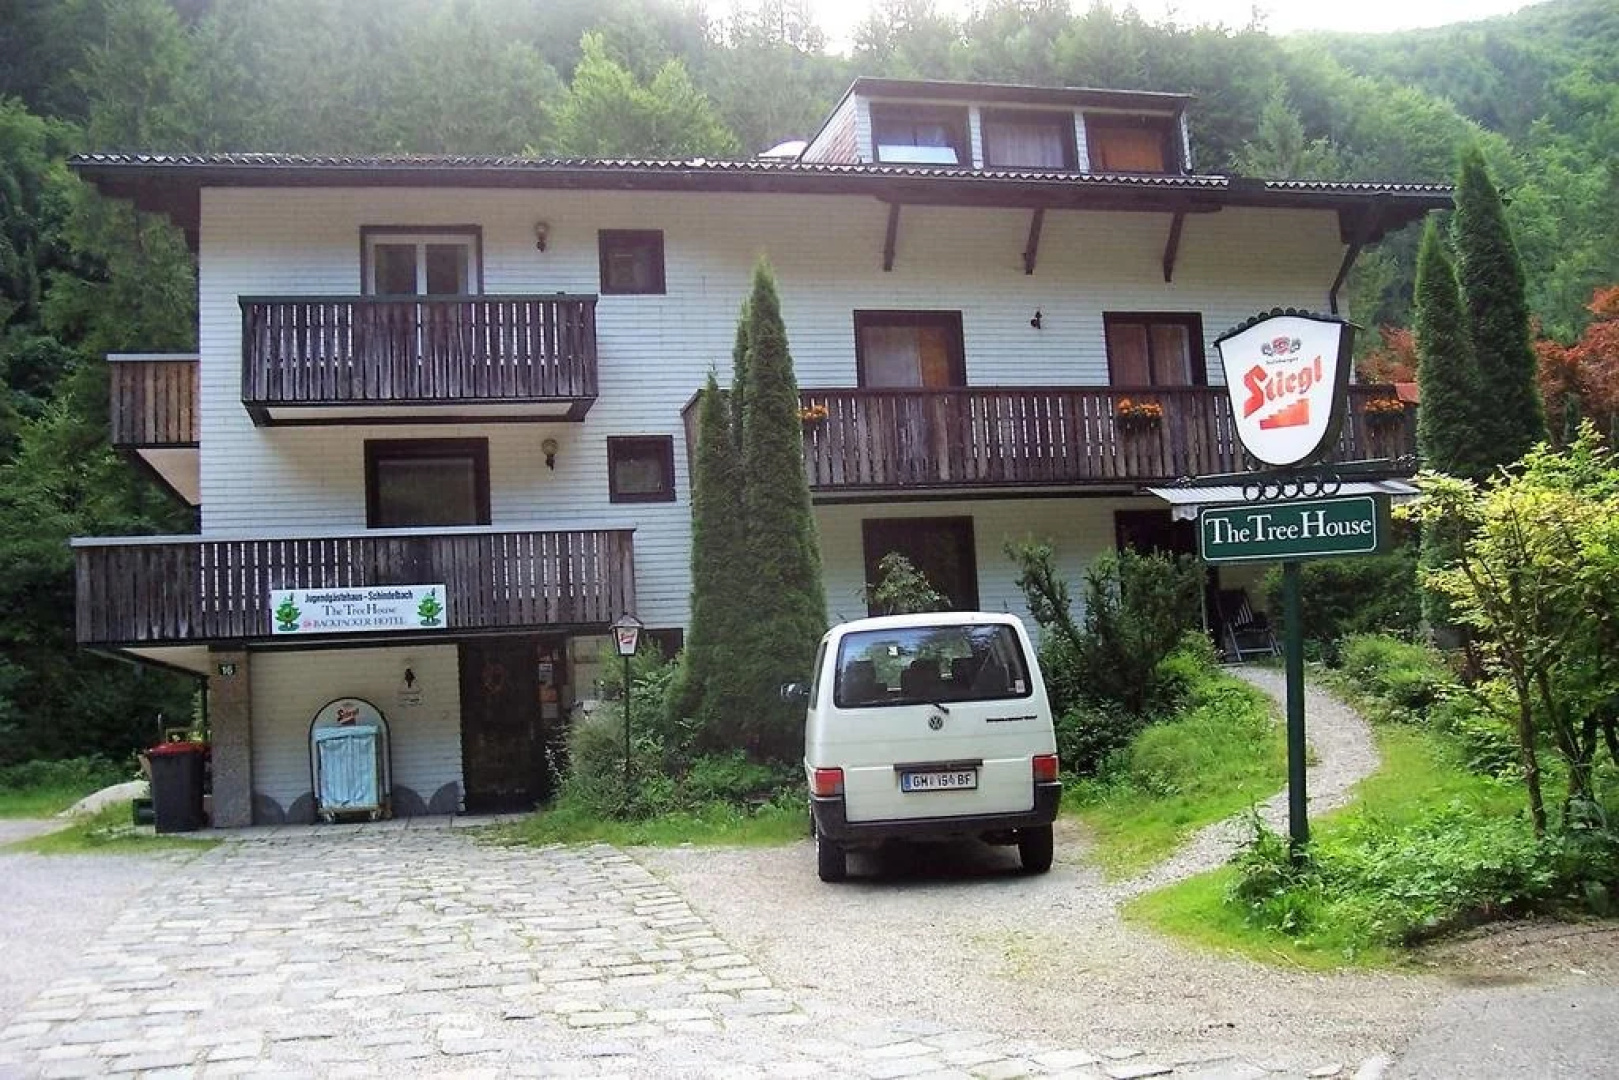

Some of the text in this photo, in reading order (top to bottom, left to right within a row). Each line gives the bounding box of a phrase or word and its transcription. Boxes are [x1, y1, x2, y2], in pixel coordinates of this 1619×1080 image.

[1243, 355, 1323, 420] Stiegl
[1204, 510, 1372, 545] The Tree House
[321, 603, 396, 616] The Tree House
[374, 616, 406, 627] HOTEL
